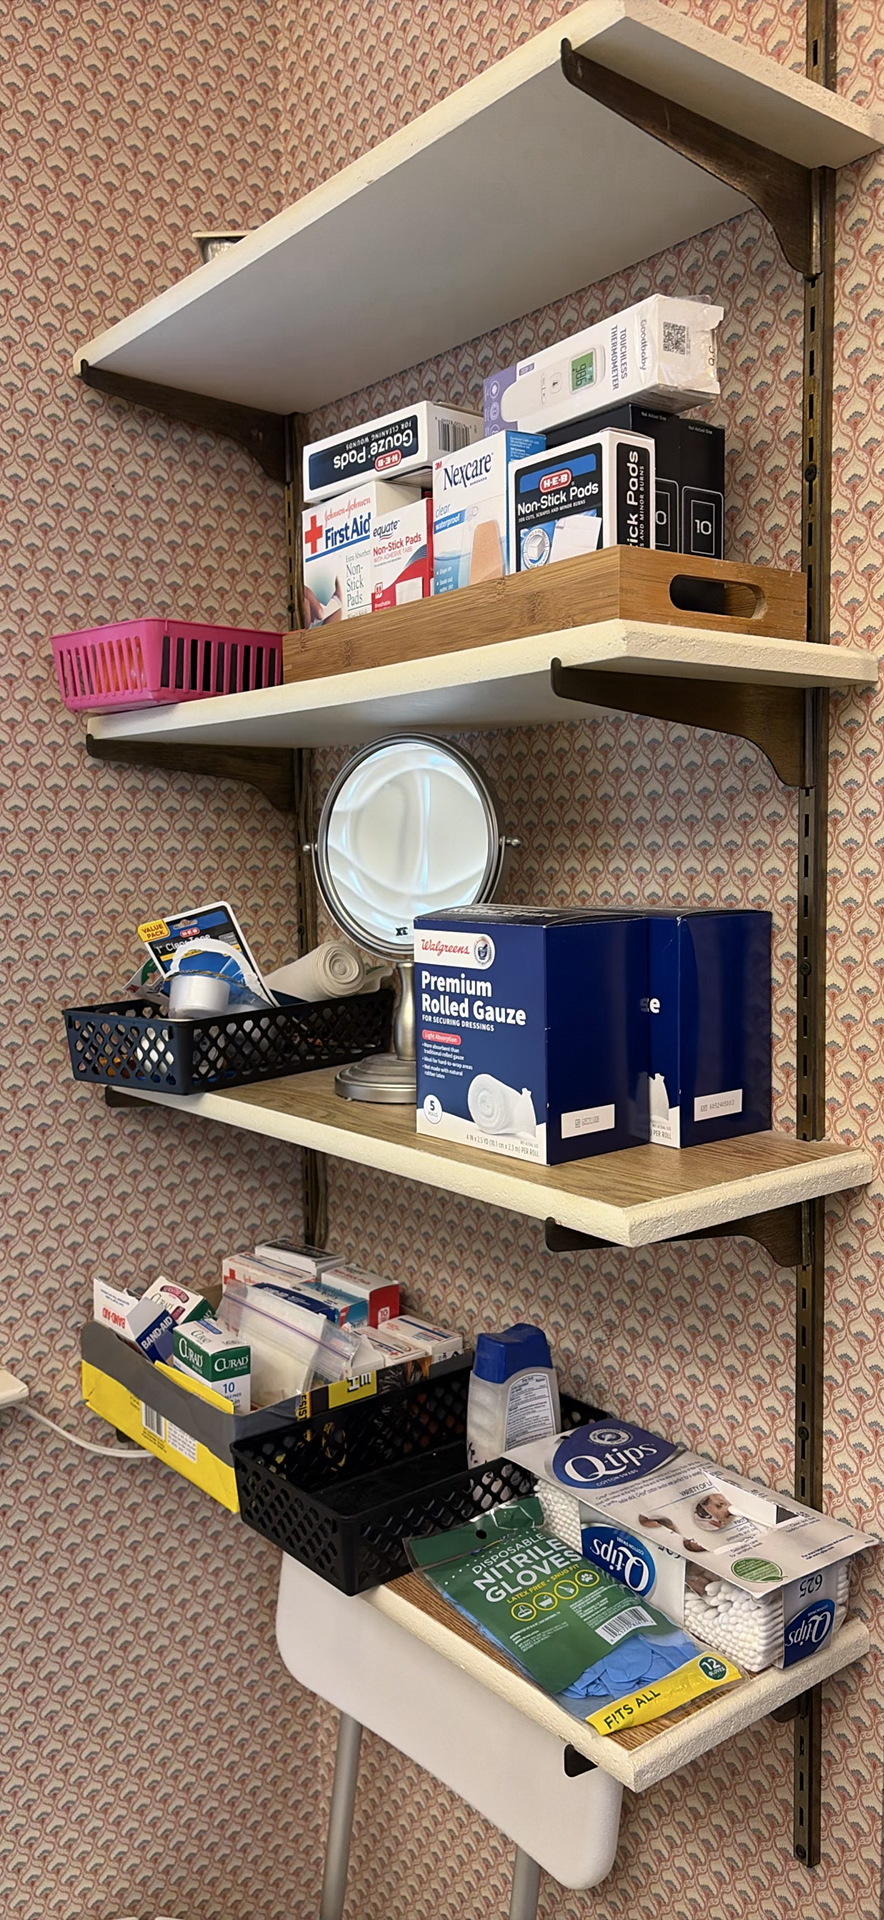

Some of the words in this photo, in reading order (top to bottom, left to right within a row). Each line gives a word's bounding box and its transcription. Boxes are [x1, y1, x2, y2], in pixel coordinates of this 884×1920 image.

[610, 325, 620, 391] THERMOMETER
[620, 328, 628, 380] TOUCHLESS
[370, 424, 400, 441] CLEANING
[400, 420, 412, 430] FOR
[346, 437, 370, 450] WOUNDS
[370, 430, 413, 456] Gauze
[334, 446, 366, 470] Pads
[434, 460, 442, 470] 3M
[443, 453, 492, 490] Nexcare
[626, 450, 638, 506] Pads
[543, 474, 568, 488] H-E-B
[518, 490, 566, 516] Non-Stick
[570, 482, 599, 500] Pads
[560, 504, 572, 512] MINOR
[573, 500, 586, 508] BURNS
[436, 502, 451, 518] clear
[325, 522, 350, 550] First
[350, 512, 371, 539] Aid
[373, 520, 398, 538] equate
[435, 514, 460, 532] waterproof
[694, 520, 712, 535] 10
[373, 537, 404, 556] Non-Stick
[405, 533, 422, 546] Pads
[384, 550, 402, 562] ADHESIVE
[402, 546, 413, 555] TABS
[346, 564, 364, 578] Non-
[346, 576, 364, 593] Stick
[347, 592, 363, 608] Pads
[141, 924, 164, 934] VALUE
[146, 930, 166, 939] PACK
[421, 939, 470, 956] Walgreens
[421, 971, 492, 997] Premium
[422, 994, 469, 1018] Rolled
[472, 1001, 526, 1026] Gauze
[422, 1014, 432, 1022] FOR
[433, 1016, 460, 1027] SECURING
[461, 1021, 494, 1032] DRESSINGS
[435, 1034, 457, 1042] Absorption
[429, 1100, 435, 1111] 5
[653, 1130, 661, 1138] PER
[662, 1131, 672, 1140] ROLL
[530, 1149, 539, 1157] ROLL
[102, 1307, 126, 1329] BAND-AID
[380, 1309, 389, 1317] 10
[141, 1316, 173, 1349] BAND-AID
[179, 1338, 203, 1368] CURAD
[214, 1356, 248, 1372] CURAD
[223, 1382, 235, 1394] 10
[564, 1443, 657, 1482] Q-tips
[596, 1476, 619, 1486] COTTON
[621, 1469, 639, 1480] SWABS
[679, 1486, 698, 1497] VARIETY
[616, 1536, 630, 1546] SWABS
[629, 1543, 645, 1555] COTTON
[472, 1532, 545, 1574] DISPOSABLE
[473, 1538, 568, 1591] NITRILE
[590, 1538, 649, 1591] Q-tips
[486, 1551, 582, 1603] GLOVES
[506, 1590, 528, 1604] LATEX
[529, 1580, 547, 1593] FREE
[550, 1570, 569, 1581] SNUG
[568, 1564, 579, 1573] FIT
[800, 1574, 822, 1598] 625
[817, 1604, 828, 1614] COTTON
[785, 1612, 831, 1646] Q-tips
[702, 1659, 721, 1671] 12
[708, 1667, 725, 1677] GLOVES
[604, 1704, 634, 1729] FITS
[636, 1689, 661, 1708] ALL
